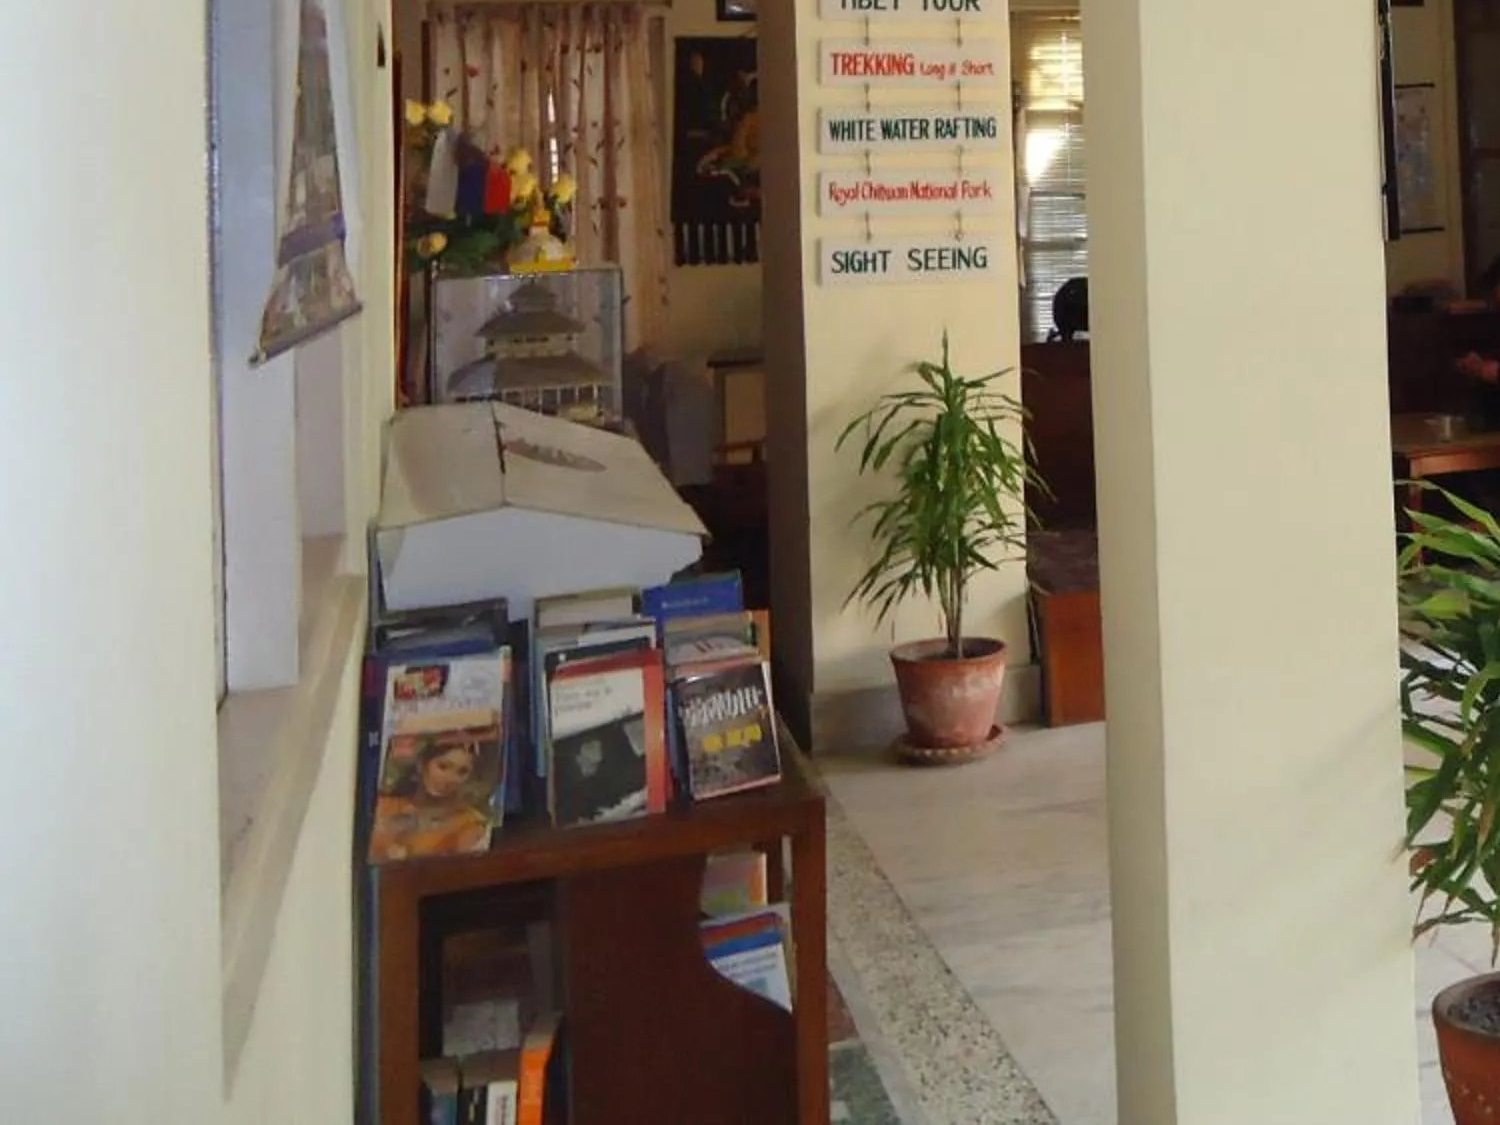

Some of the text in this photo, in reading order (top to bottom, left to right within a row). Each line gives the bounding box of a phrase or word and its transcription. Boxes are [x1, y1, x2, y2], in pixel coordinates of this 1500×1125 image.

[830, 52, 915, 76] TREKKING
[920, 62, 945, 81] Long
[961, 59, 994, 76] Short
[829, 116, 997, 142] WHITE WATER RAFTING
[829, 182, 859, 206] Royal
[910, 179, 957, 202] National
[961, 179, 992, 200] Park
[831, 246, 988, 274] SIGHT SEEING
